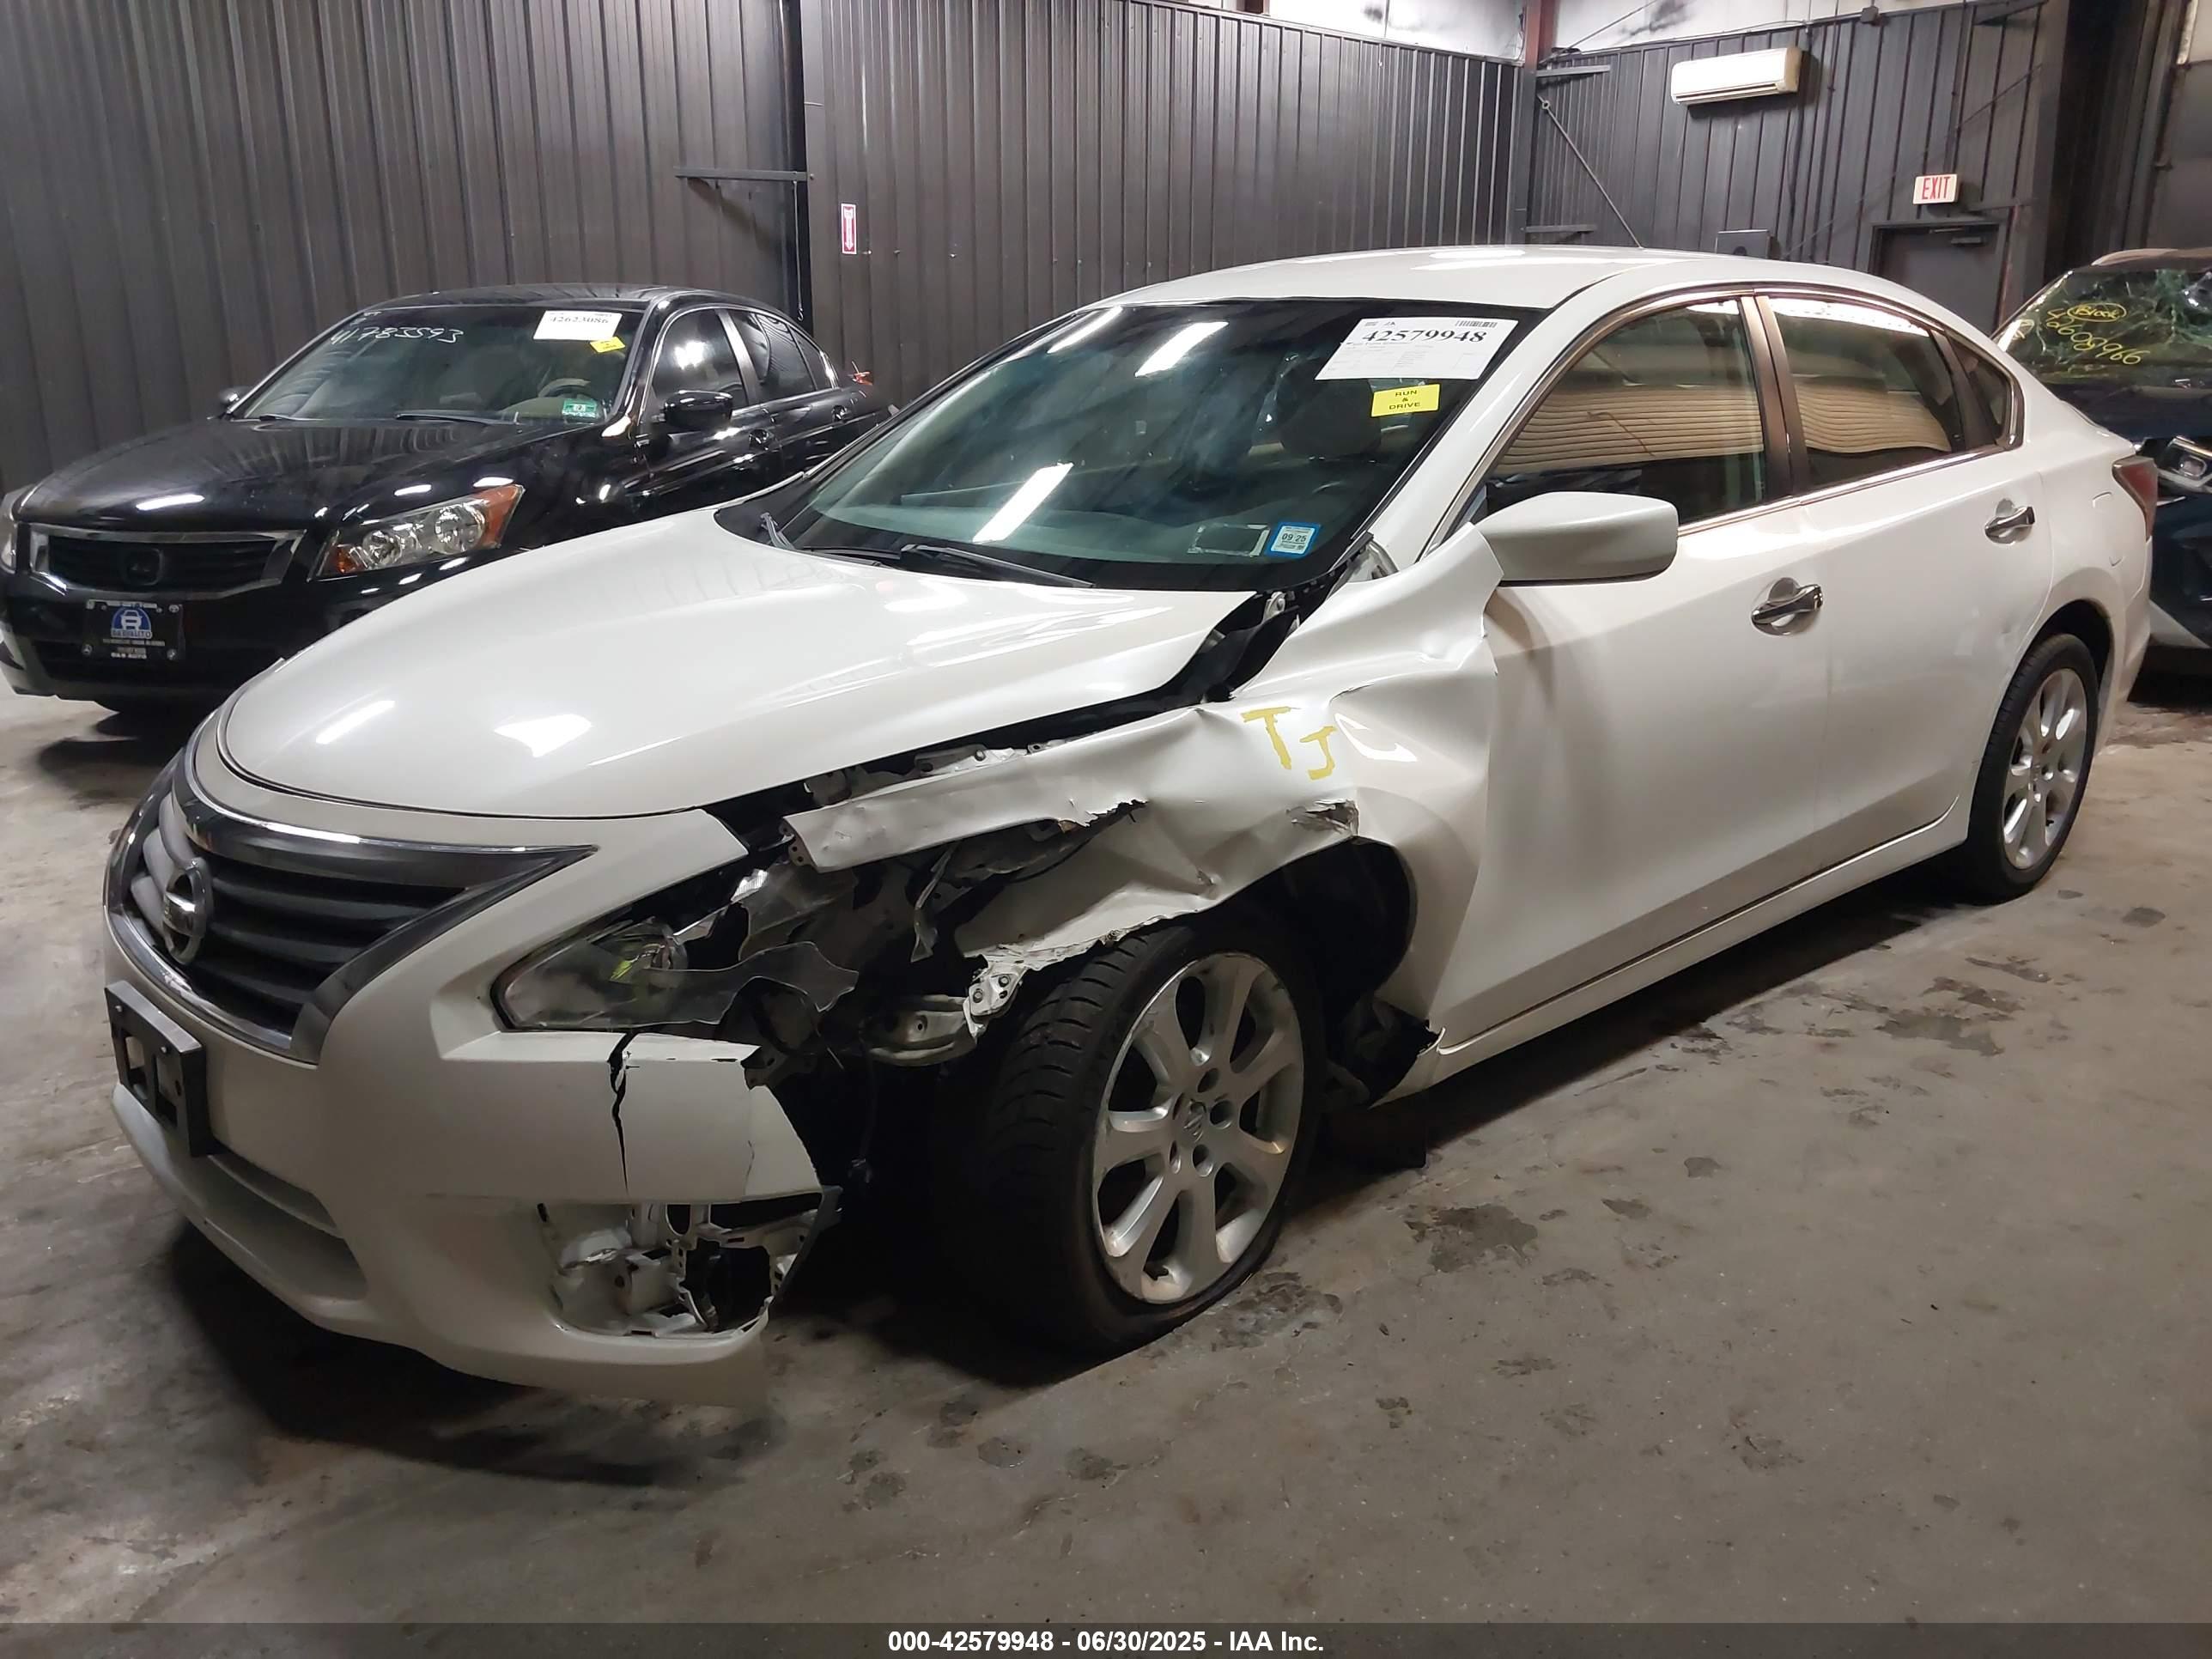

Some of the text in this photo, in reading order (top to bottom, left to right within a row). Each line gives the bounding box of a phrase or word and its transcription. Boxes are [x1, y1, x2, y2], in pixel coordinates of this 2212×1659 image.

[1922, 176, 1951, 200] EXIT
[1363, 329, 1487, 343] 42579948
[1282, 532, 1293, 541] 09
